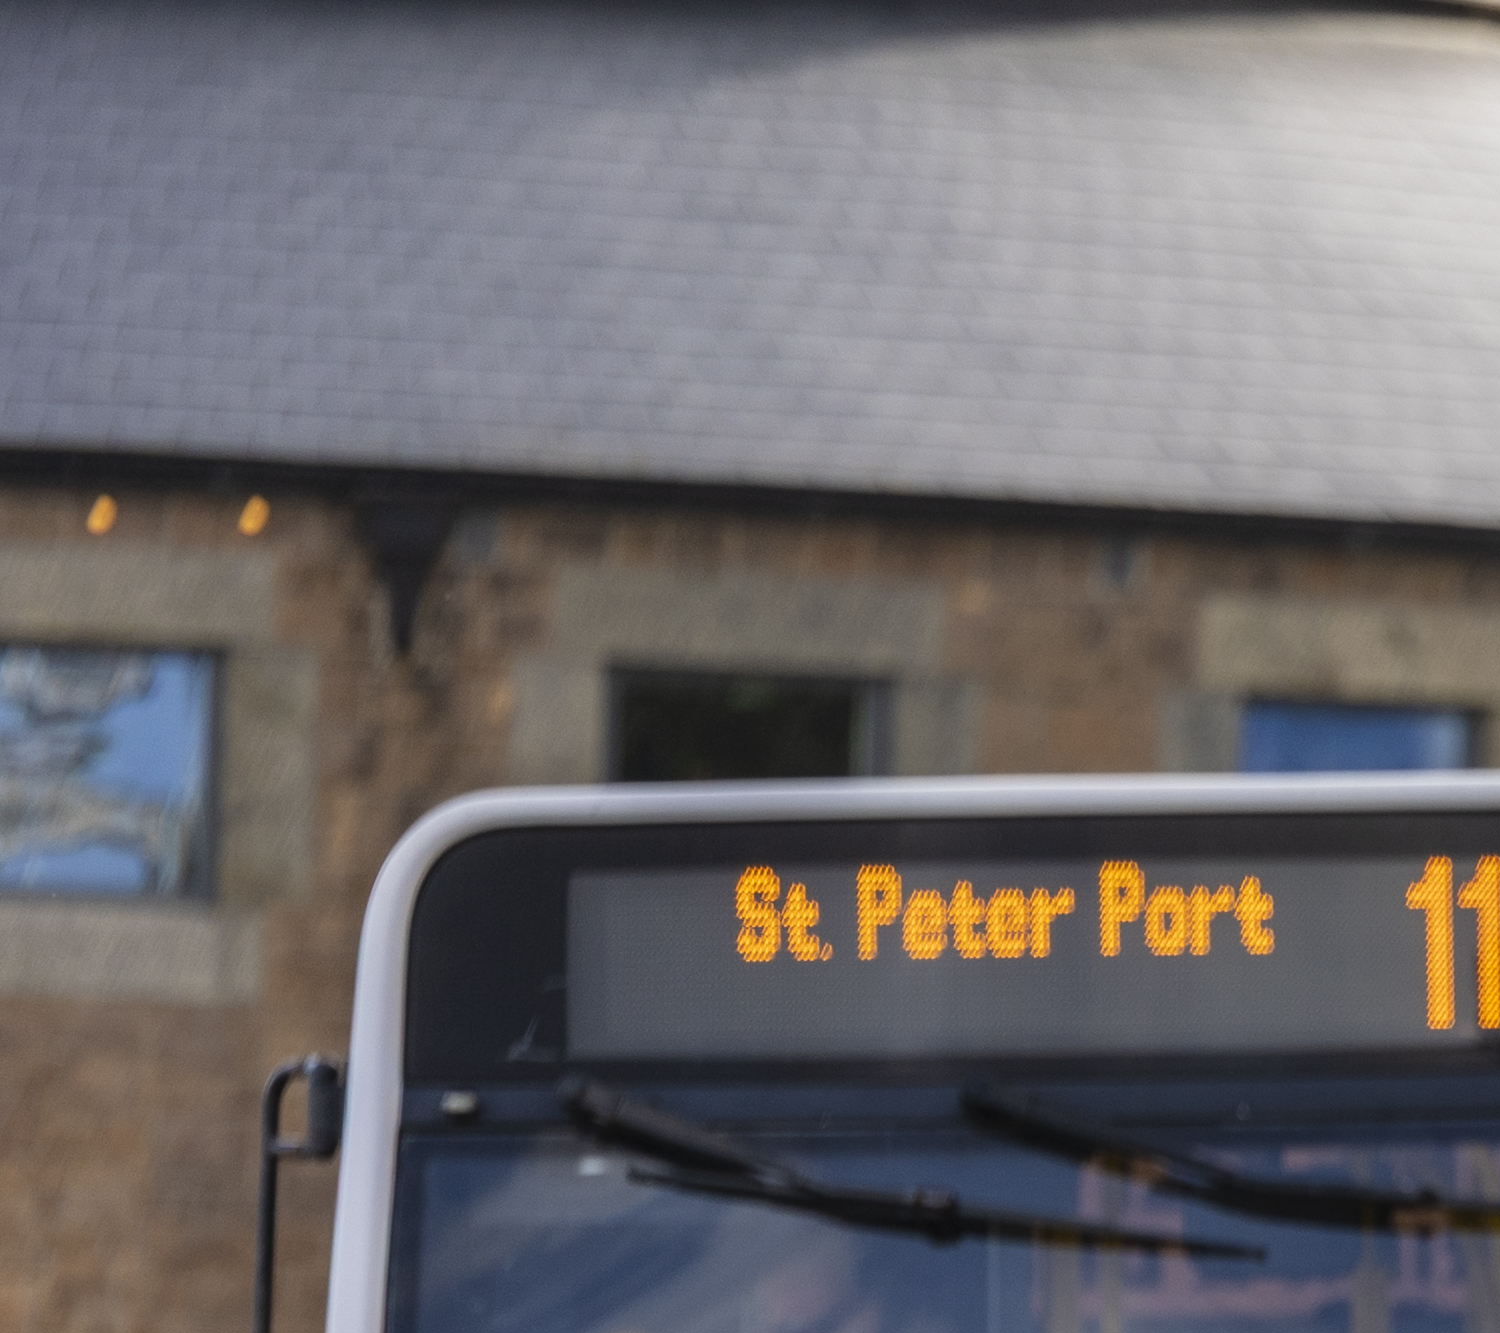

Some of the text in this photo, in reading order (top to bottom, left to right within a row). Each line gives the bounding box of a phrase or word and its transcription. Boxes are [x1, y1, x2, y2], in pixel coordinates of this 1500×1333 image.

[736, 860, 1275, 962] St. Peter Port
